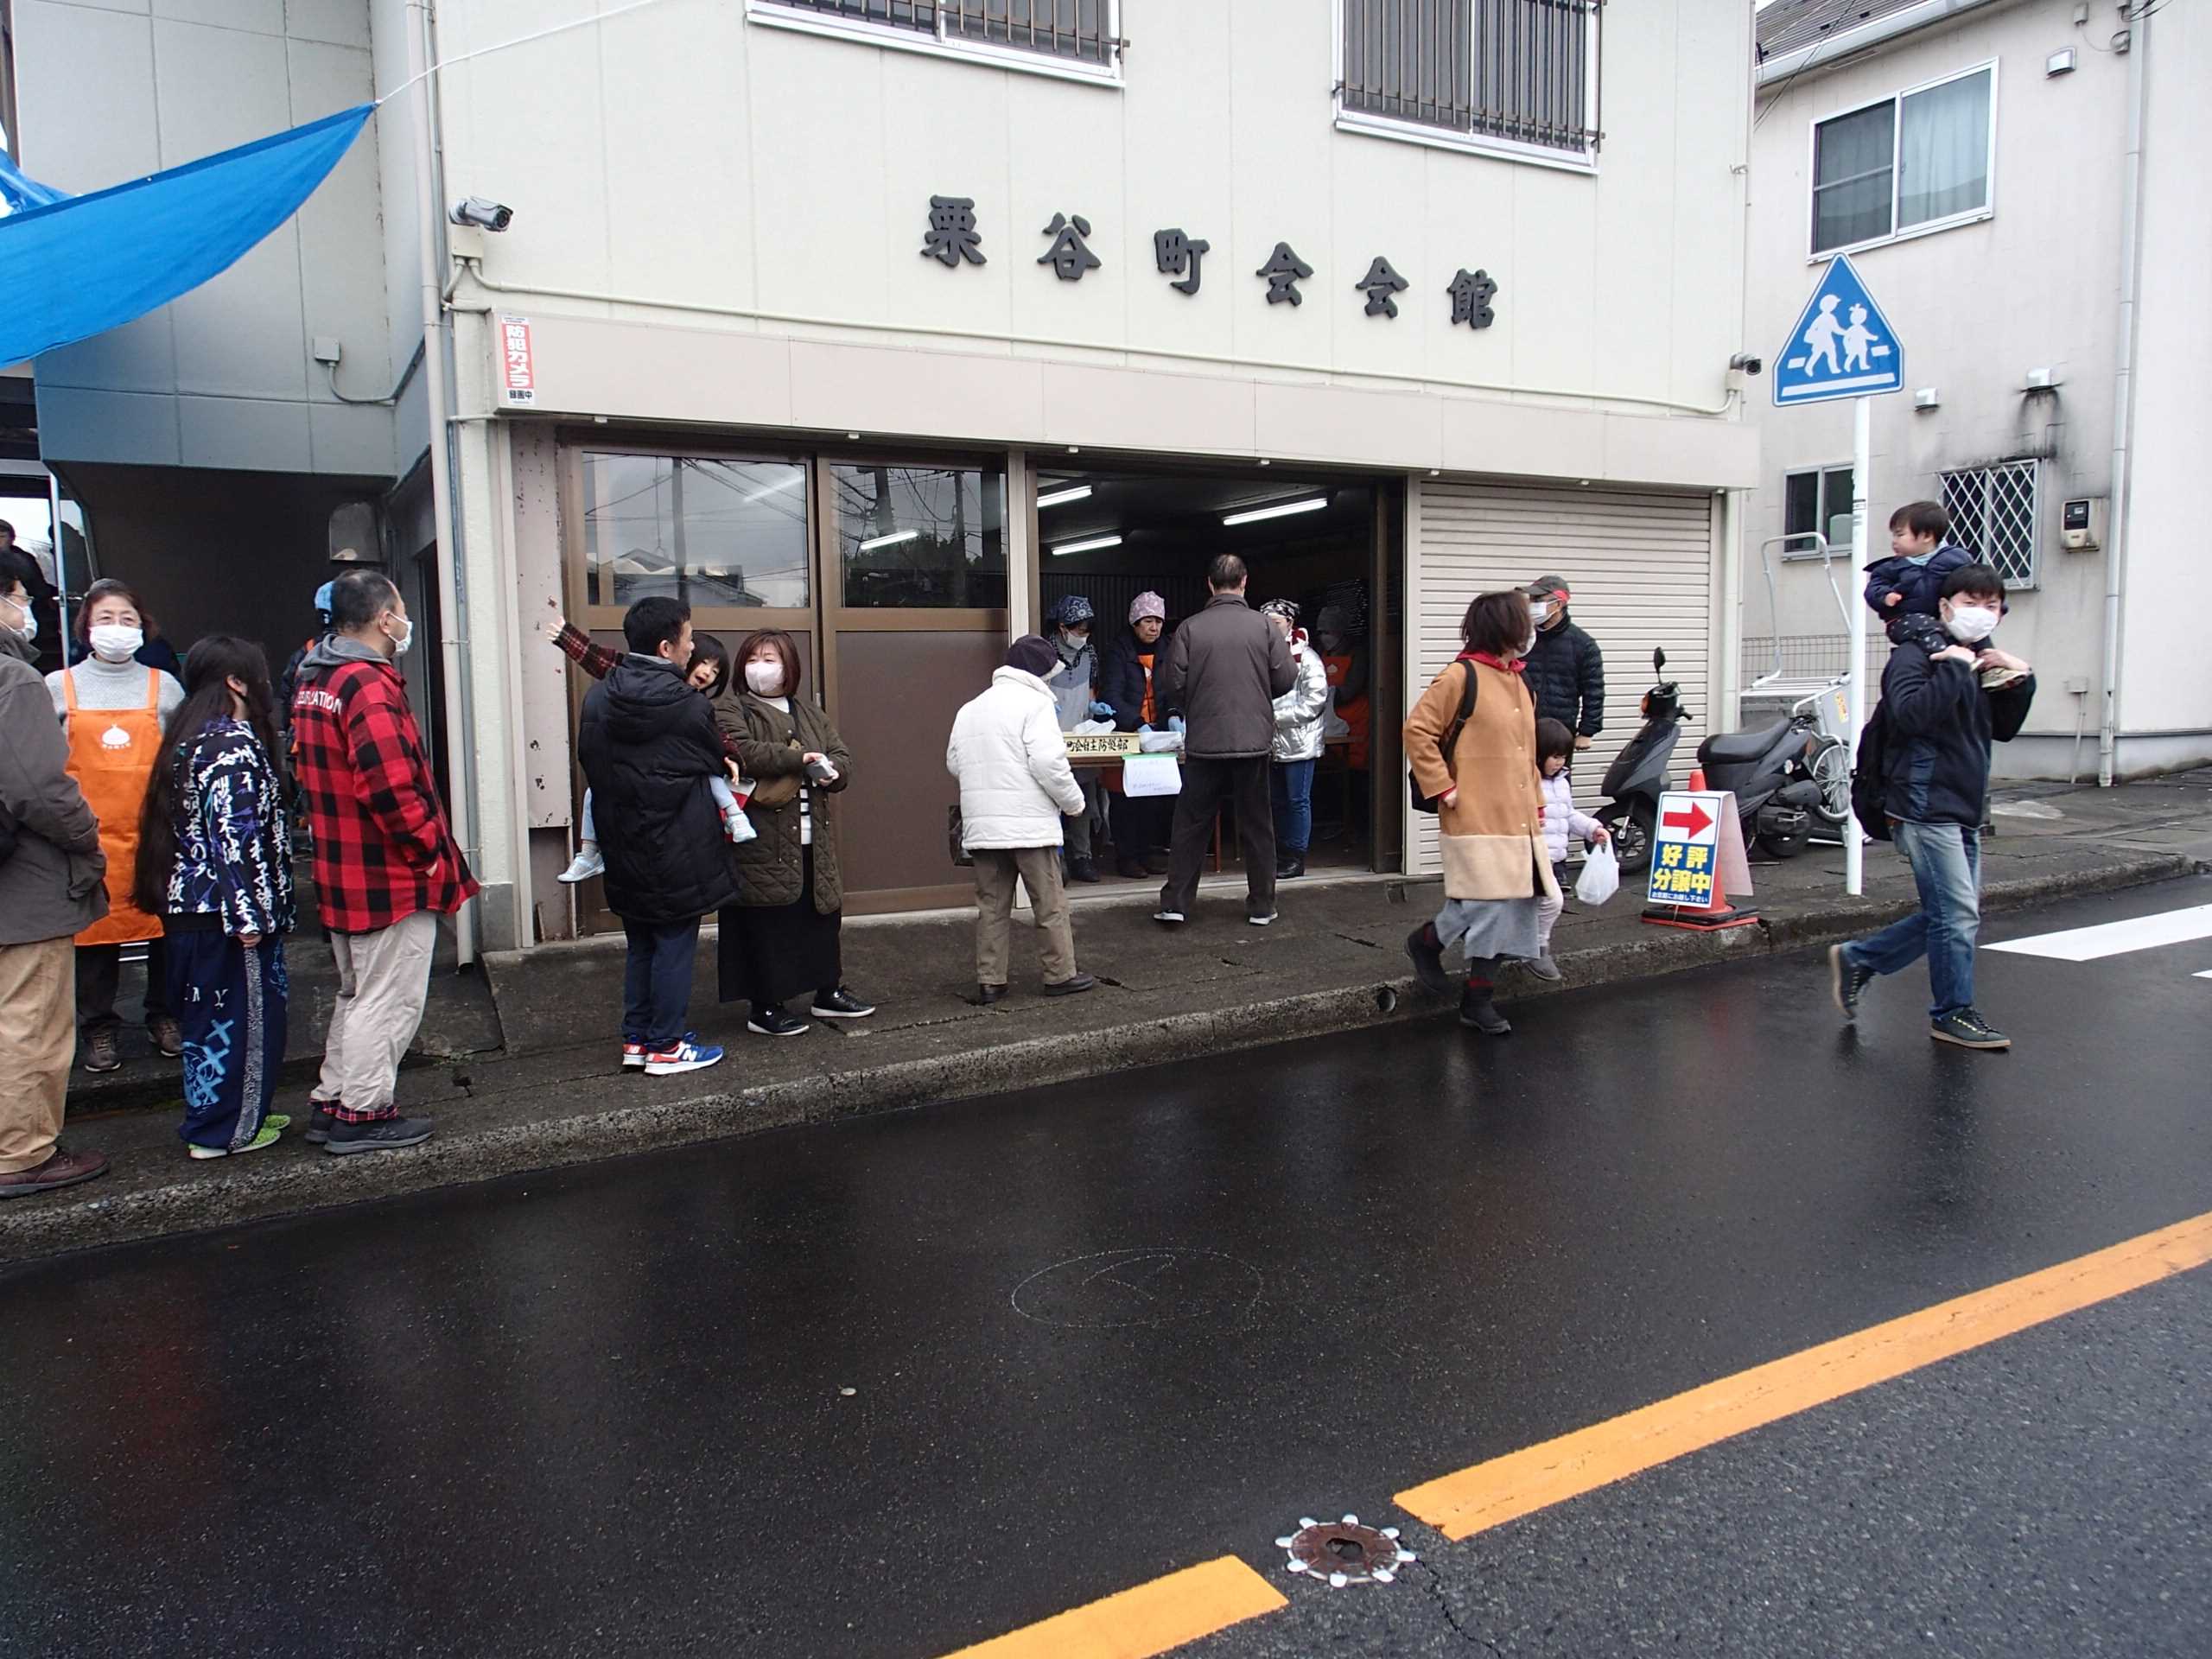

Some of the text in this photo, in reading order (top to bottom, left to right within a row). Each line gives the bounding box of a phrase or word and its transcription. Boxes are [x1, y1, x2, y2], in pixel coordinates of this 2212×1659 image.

[921, 194, 1497, 330] 栗谷町会会館
[1662, 844, 1708, 868] 好評
[1653, 868, 1711, 893] 分譲中
